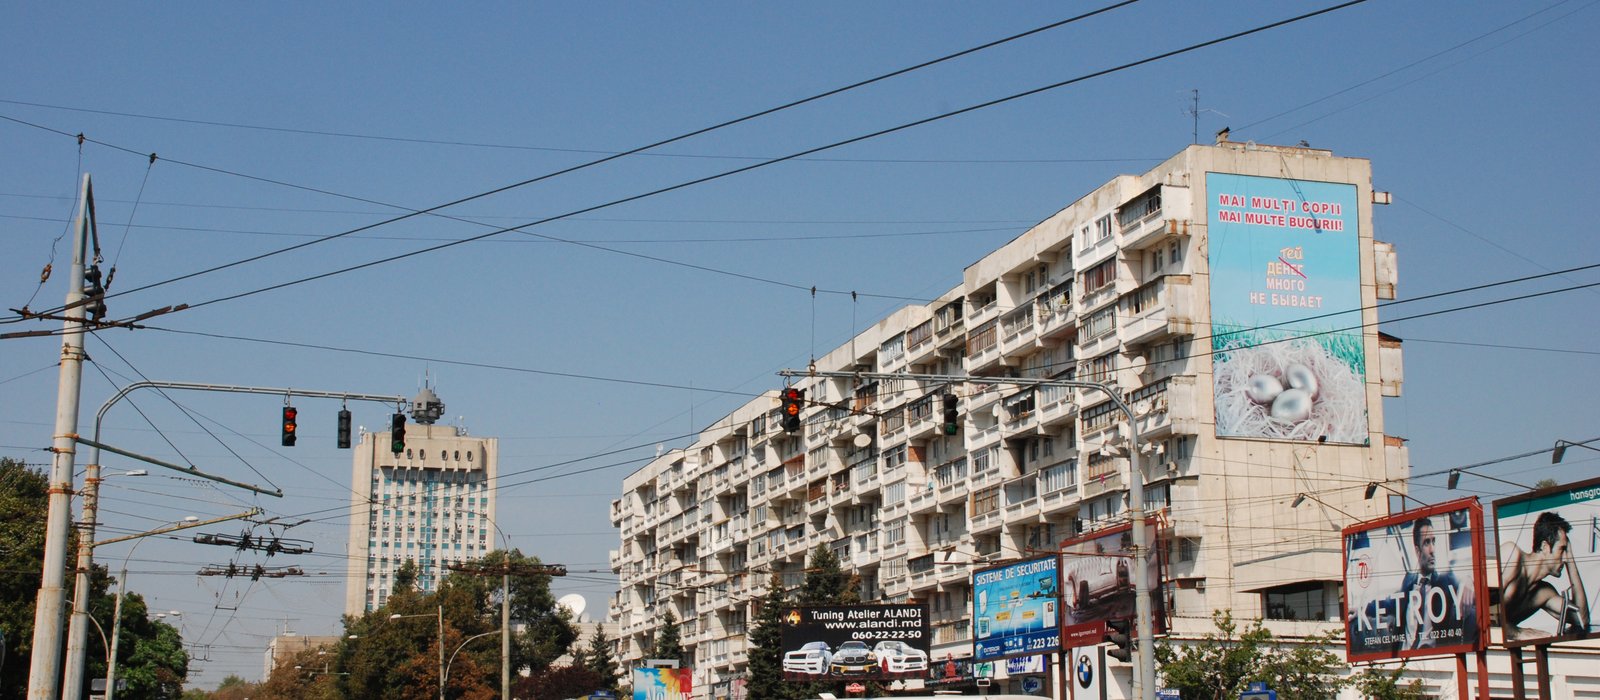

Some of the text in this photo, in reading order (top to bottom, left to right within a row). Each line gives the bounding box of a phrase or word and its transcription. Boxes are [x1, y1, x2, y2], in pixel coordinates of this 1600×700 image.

[1219, 195, 1245, 207] MAI
[1302, 202, 1342, 215] COPII
[1219, 211, 1343, 231] MAI MULTE BUCURII!
[1267, 262, 1304, 276] ДЕНЕГ
[1266, 278, 1305, 291] МНОГО
[1250, 292, 1322, 308] НЕ БЫВАЕТ
[976, 558, 1057, 586] SISTEME DE SECURITATE
[812, 609, 922, 621] Tuning Atelier ALANDI
[1358, 585, 1464, 632] KETROY
[825, 619, 922, 629] www.alandi.md
[852, 630, 922, 640] 060-22-22-50
[1440, 629, 1447, 638] 23
[1032, 639, 1045, 650] 223
[1047, 636, 1060, 648] 226
